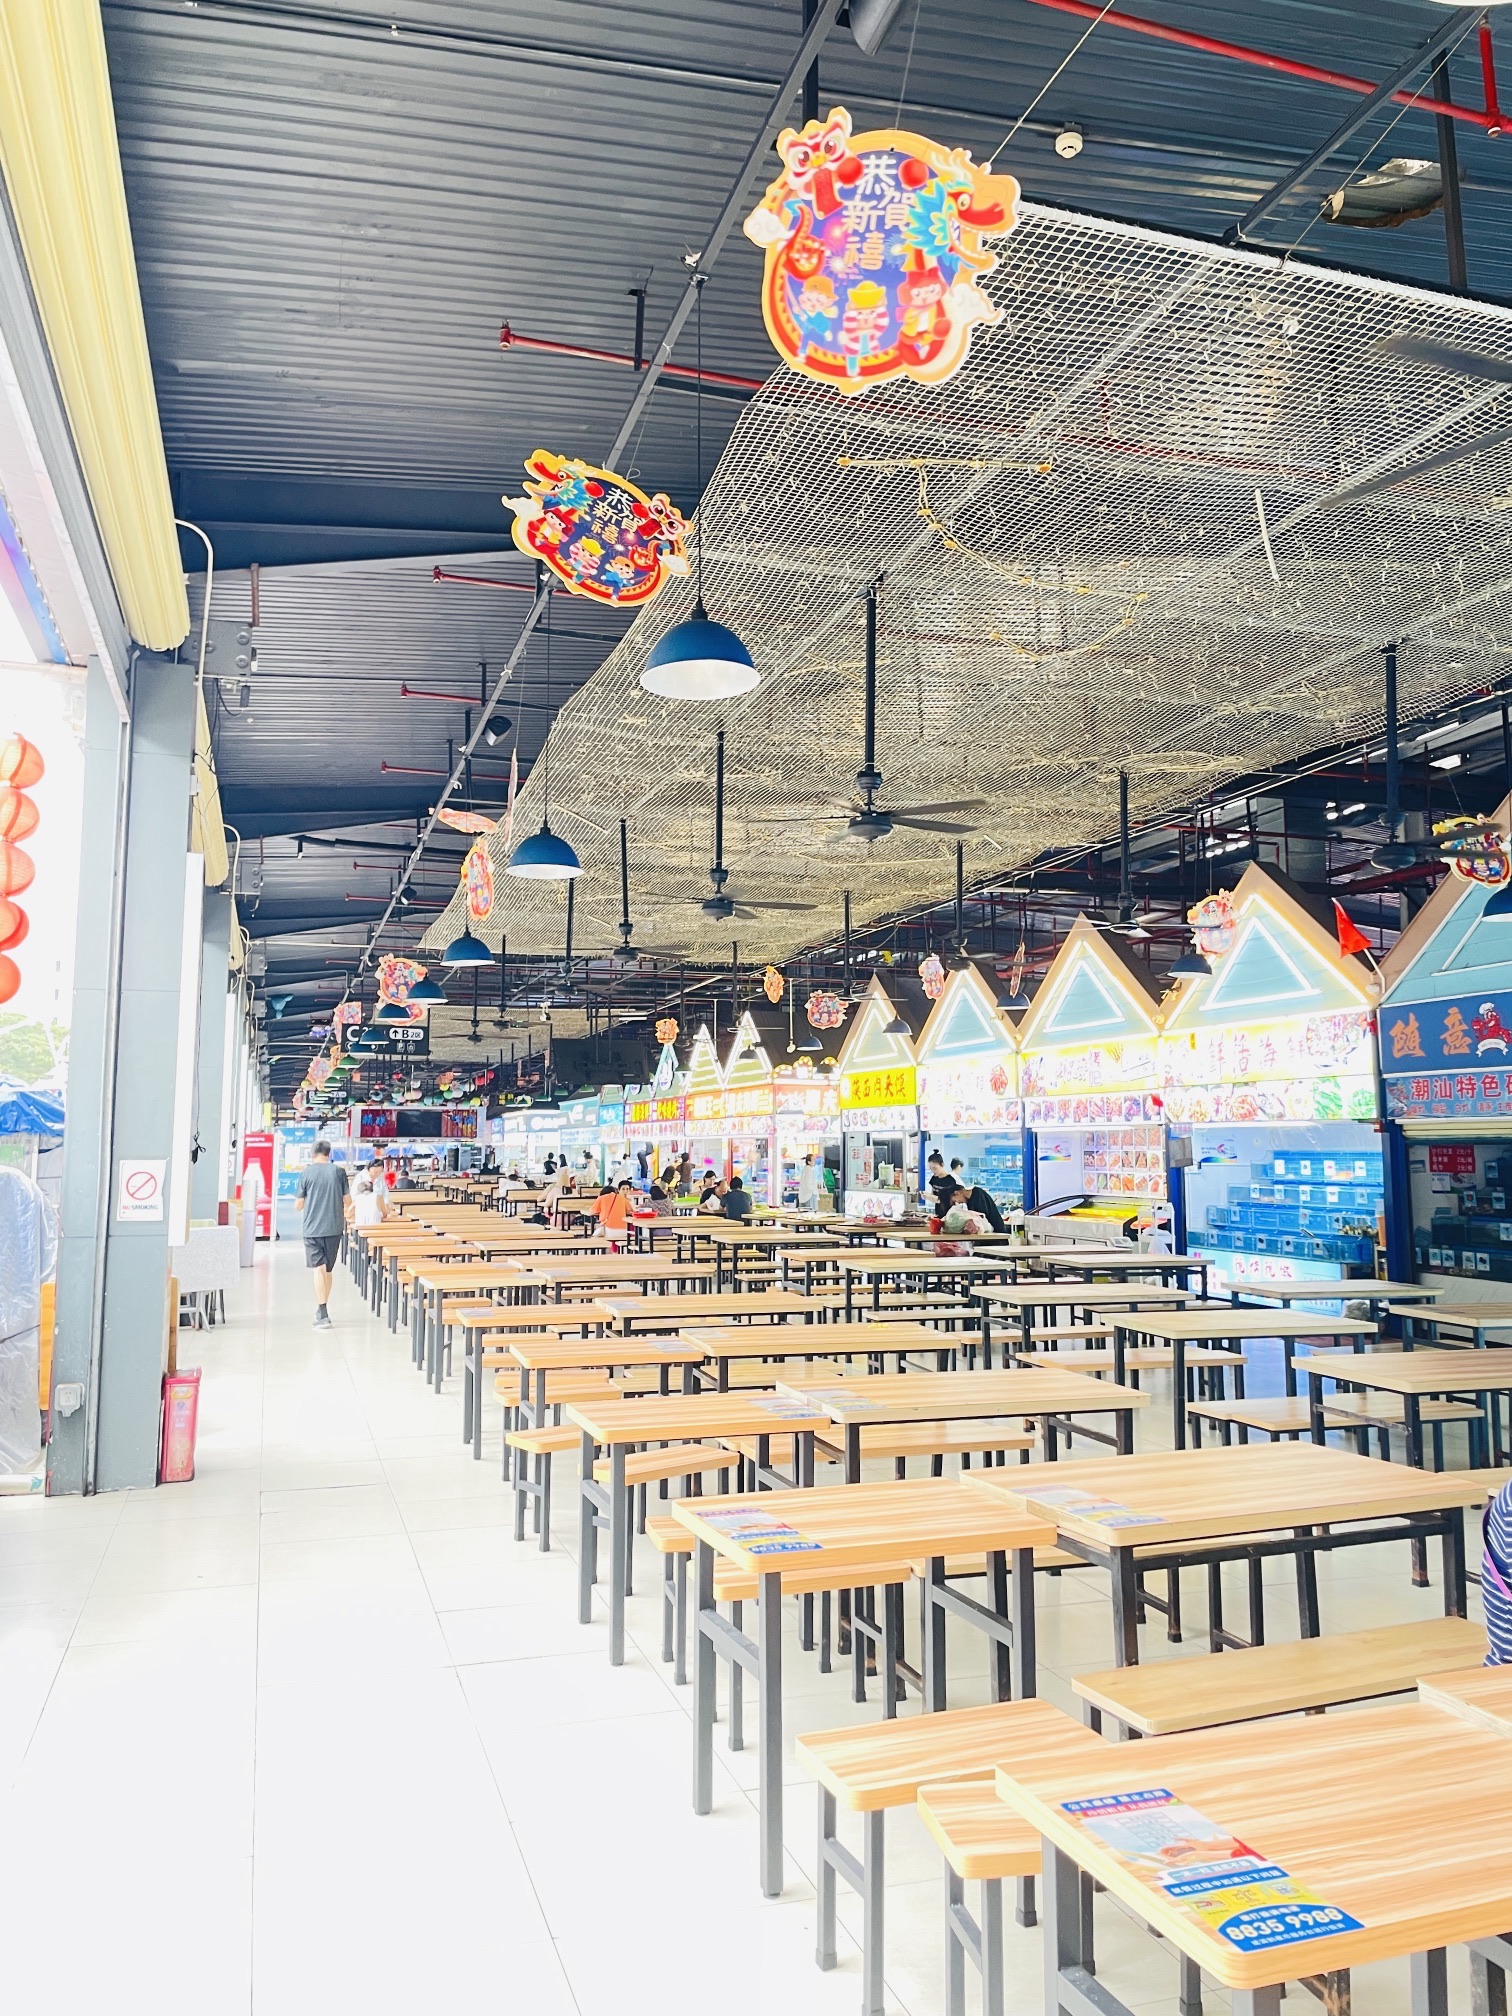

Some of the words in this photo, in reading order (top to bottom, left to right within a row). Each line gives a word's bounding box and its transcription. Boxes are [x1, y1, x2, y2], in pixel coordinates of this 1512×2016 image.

[1388, 1007, 1474, 1059] 随意
[1226, 1919, 1285, 1941] 8835
[1285, 1908, 1343, 1929] 9988
